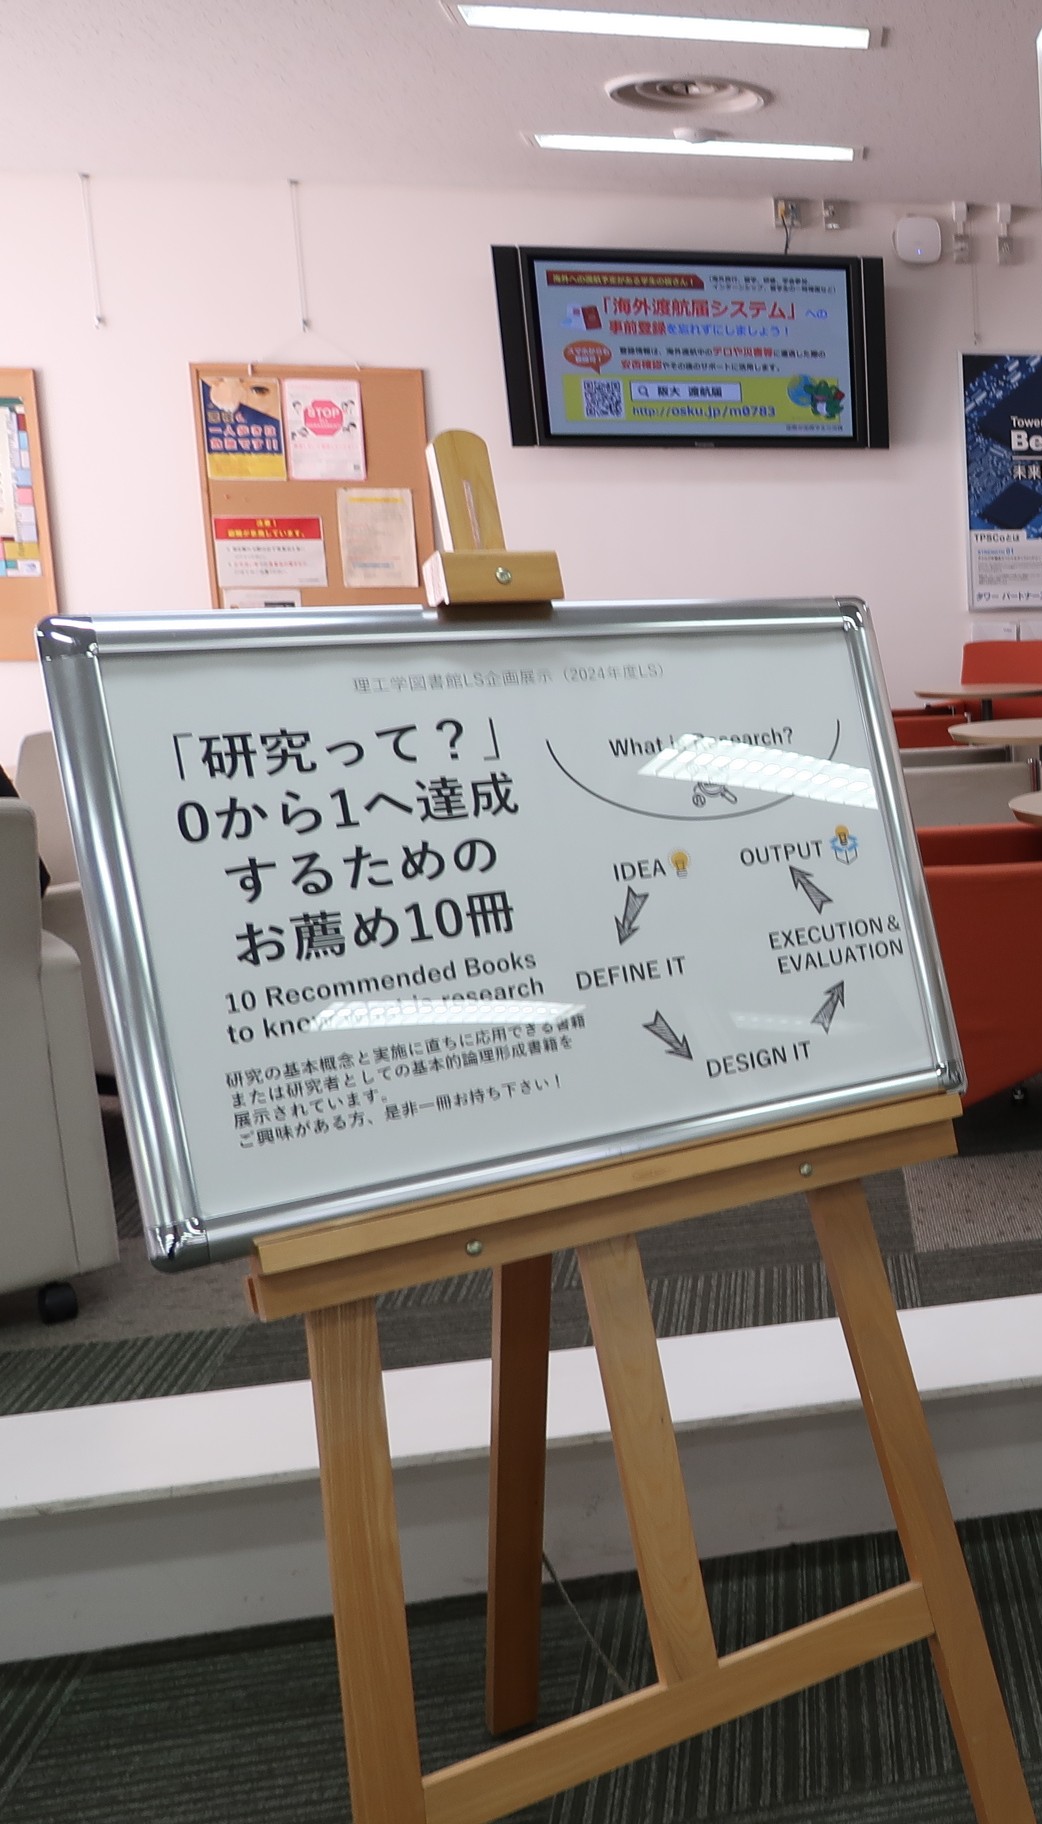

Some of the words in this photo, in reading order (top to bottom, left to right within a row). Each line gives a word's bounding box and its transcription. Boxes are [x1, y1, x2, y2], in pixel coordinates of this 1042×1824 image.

[975, 533, 1020, 542] TPSCoとは
[608, 736, 663, 758] What
[177, 771, 520, 844] 0から1へ達成
[224, 836, 498, 903] するための
[613, 858, 666, 882] IDEA
[740, 840, 823, 867] OUTPUT
[235, 890, 515, 966] お薦め10冊
[768, 915, 884, 951] EXECUTION
[887, 914, 900, 931] &
[575, 960, 661, 991] DEFINE
[666, 955, 686, 977] IT
[777, 938, 904, 976] EVALUATION
[225, 991, 257, 1014] 10
[265, 960, 457, 1009] Recommended
[464, 951, 537, 978] Books
[227, 1025, 254, 1045] to
[442, 976, 545, 1009] research
[232, 1033, 574, 1108] または研究者としての基本的論理形成書籍を
[706, 1045, 788, 1079] DESIGN
[793, 1040, 812, 1061] IT
[234, 1086, 389, 1130] 展示されています。
